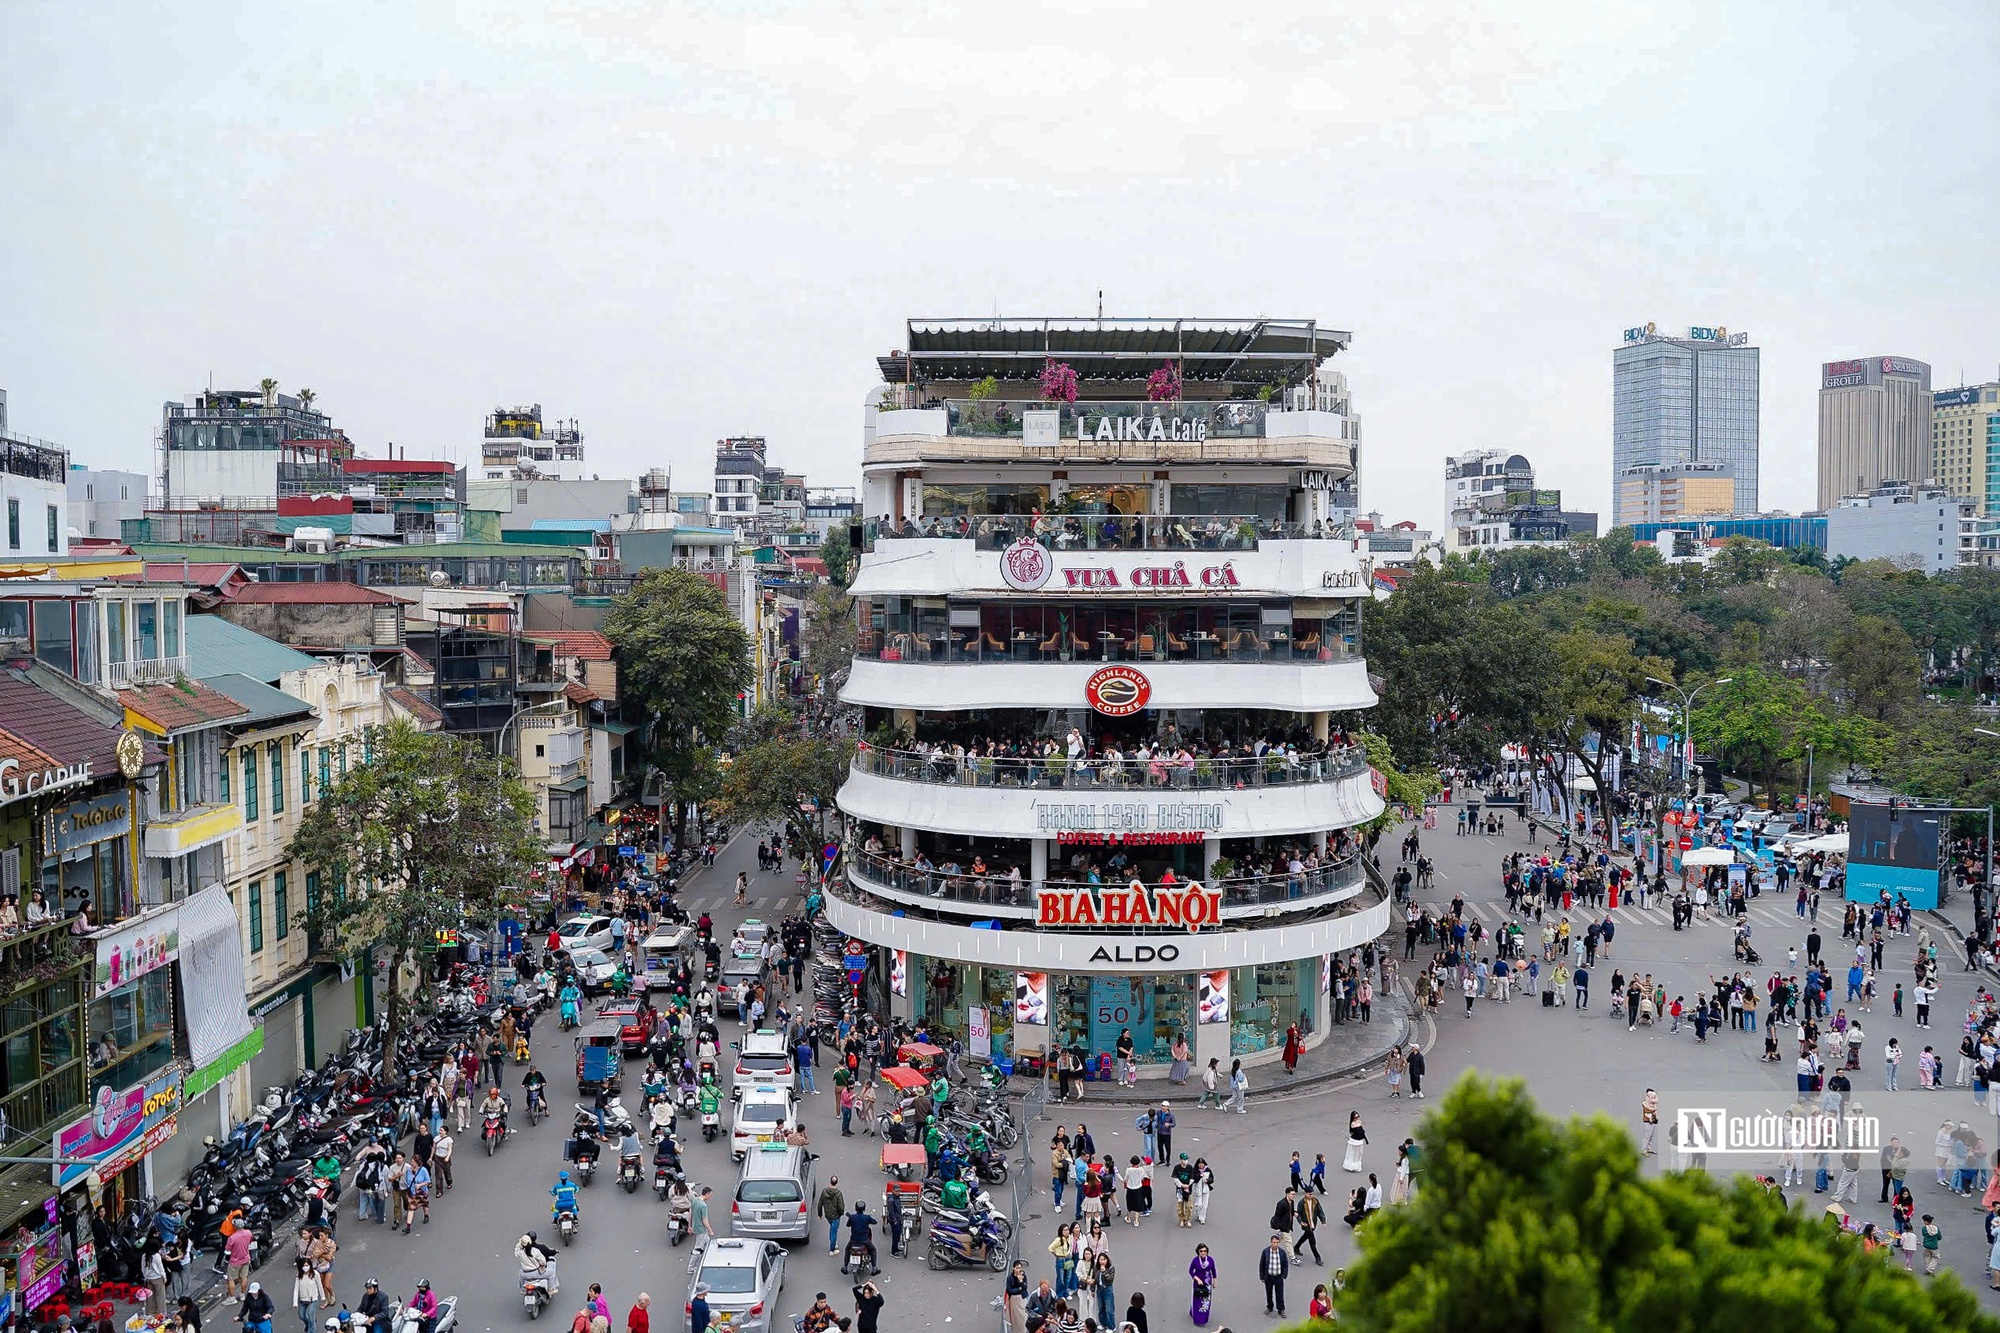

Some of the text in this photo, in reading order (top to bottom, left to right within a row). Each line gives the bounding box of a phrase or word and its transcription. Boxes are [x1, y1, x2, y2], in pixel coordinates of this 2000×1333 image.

[1624, 326, 1646, 341] BIDV
[1691, 327, 1717, 340] BIDV
[1825, 376, 1863, 388] GROUP
[1078, 415, 1206, 441] LAIKA Café
[1300, 470, 1334, 491] LAIKA
[1061, 560, 1241, 588] VUA CHẢ CÁ
[1089, 669, 1148, 690] HIGHLANDS
[1096, 701, 1142, 714] COFFEE
[1036, 804, 1224, 829] HANOI 1930 BISTRO
[1056, 831, 1205, 846] COFFEE & RESTAURANT
[1036, 883, 1223, 932] BIA HÀ NỘI
[1088, 944, 1180, 962] ALDO
[1097, 1006, 1130, 1024] 50
[970, 1025, 985, 1039] 50
